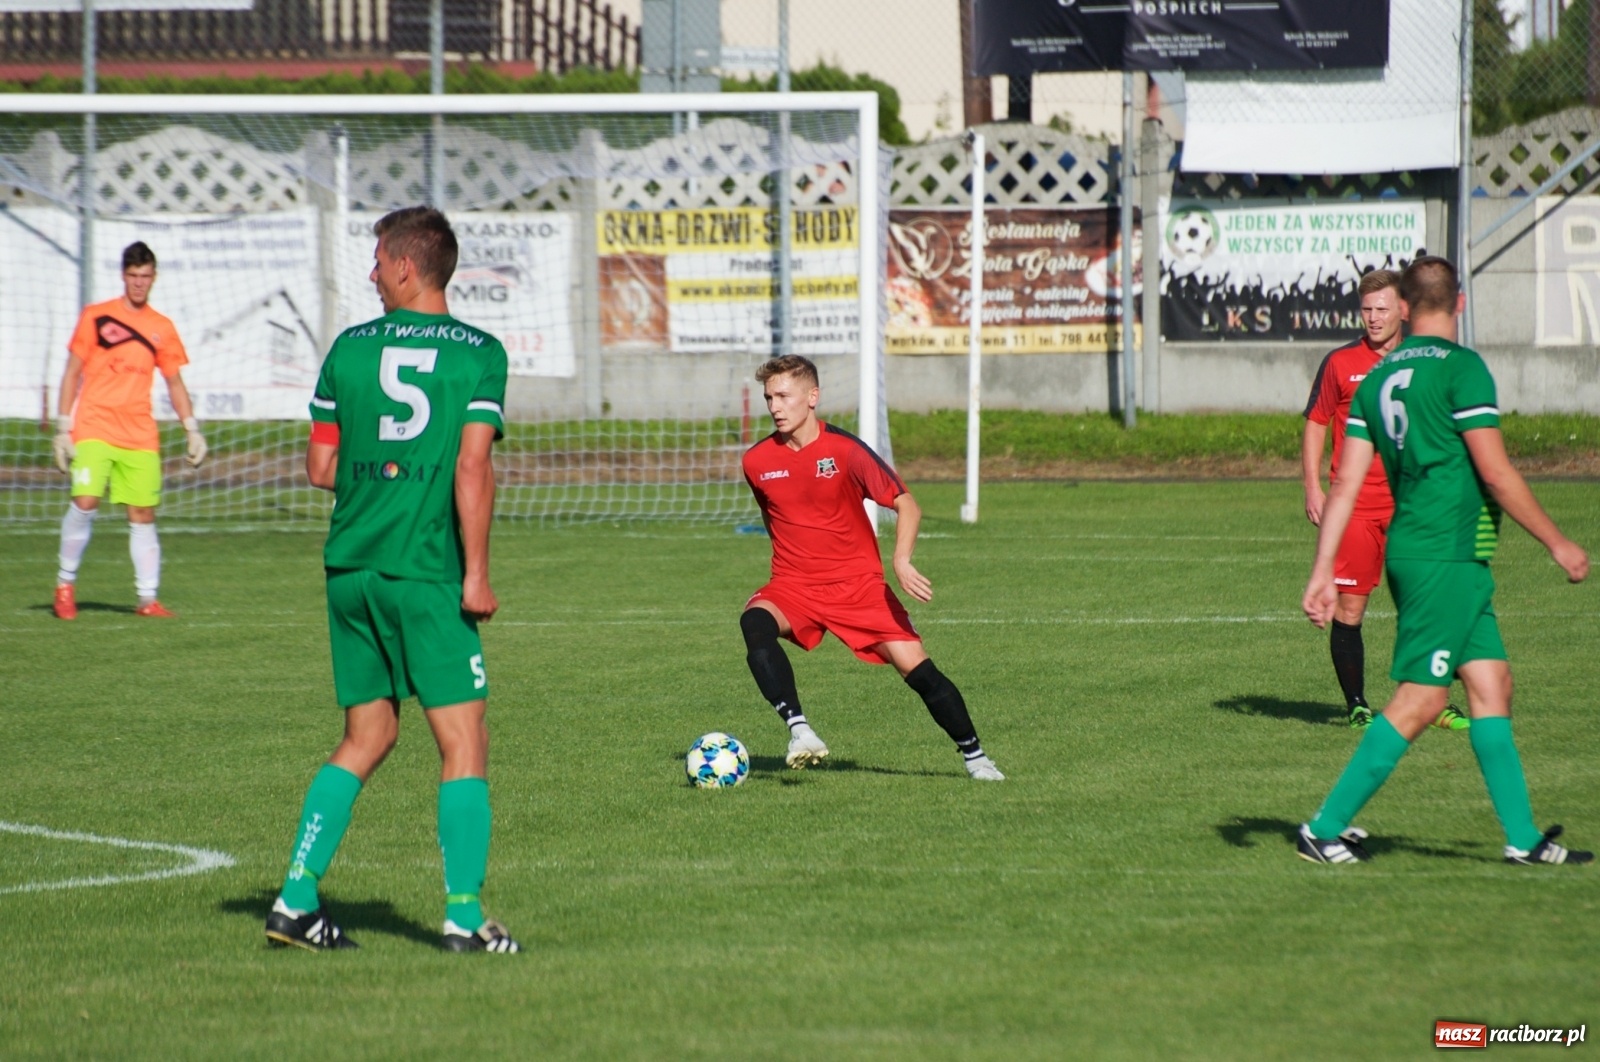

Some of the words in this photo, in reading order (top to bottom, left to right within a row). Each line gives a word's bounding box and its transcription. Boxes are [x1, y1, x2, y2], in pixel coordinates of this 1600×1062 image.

[1224, 214, 1278, 231] JEDEN
[1283, 214, 1304, 230] ZA
[1309, 213, 1416, 230] WSZYSTKICH
[1227, 237, 1304, 254] WSZYSCY
[1310, 237, 1331, 253] ZA
[1336, 236, 1413, 254] JEDNEGO
[1013, 332, 1027, 346] 11
[1061, 330, 1082, 345] 798
[378, 345, 439, 442] 5
[1378, 367, 1415, 450] 6
[469, 652, 486, 690] 5
[1430, 649, 1451, 678] 6
